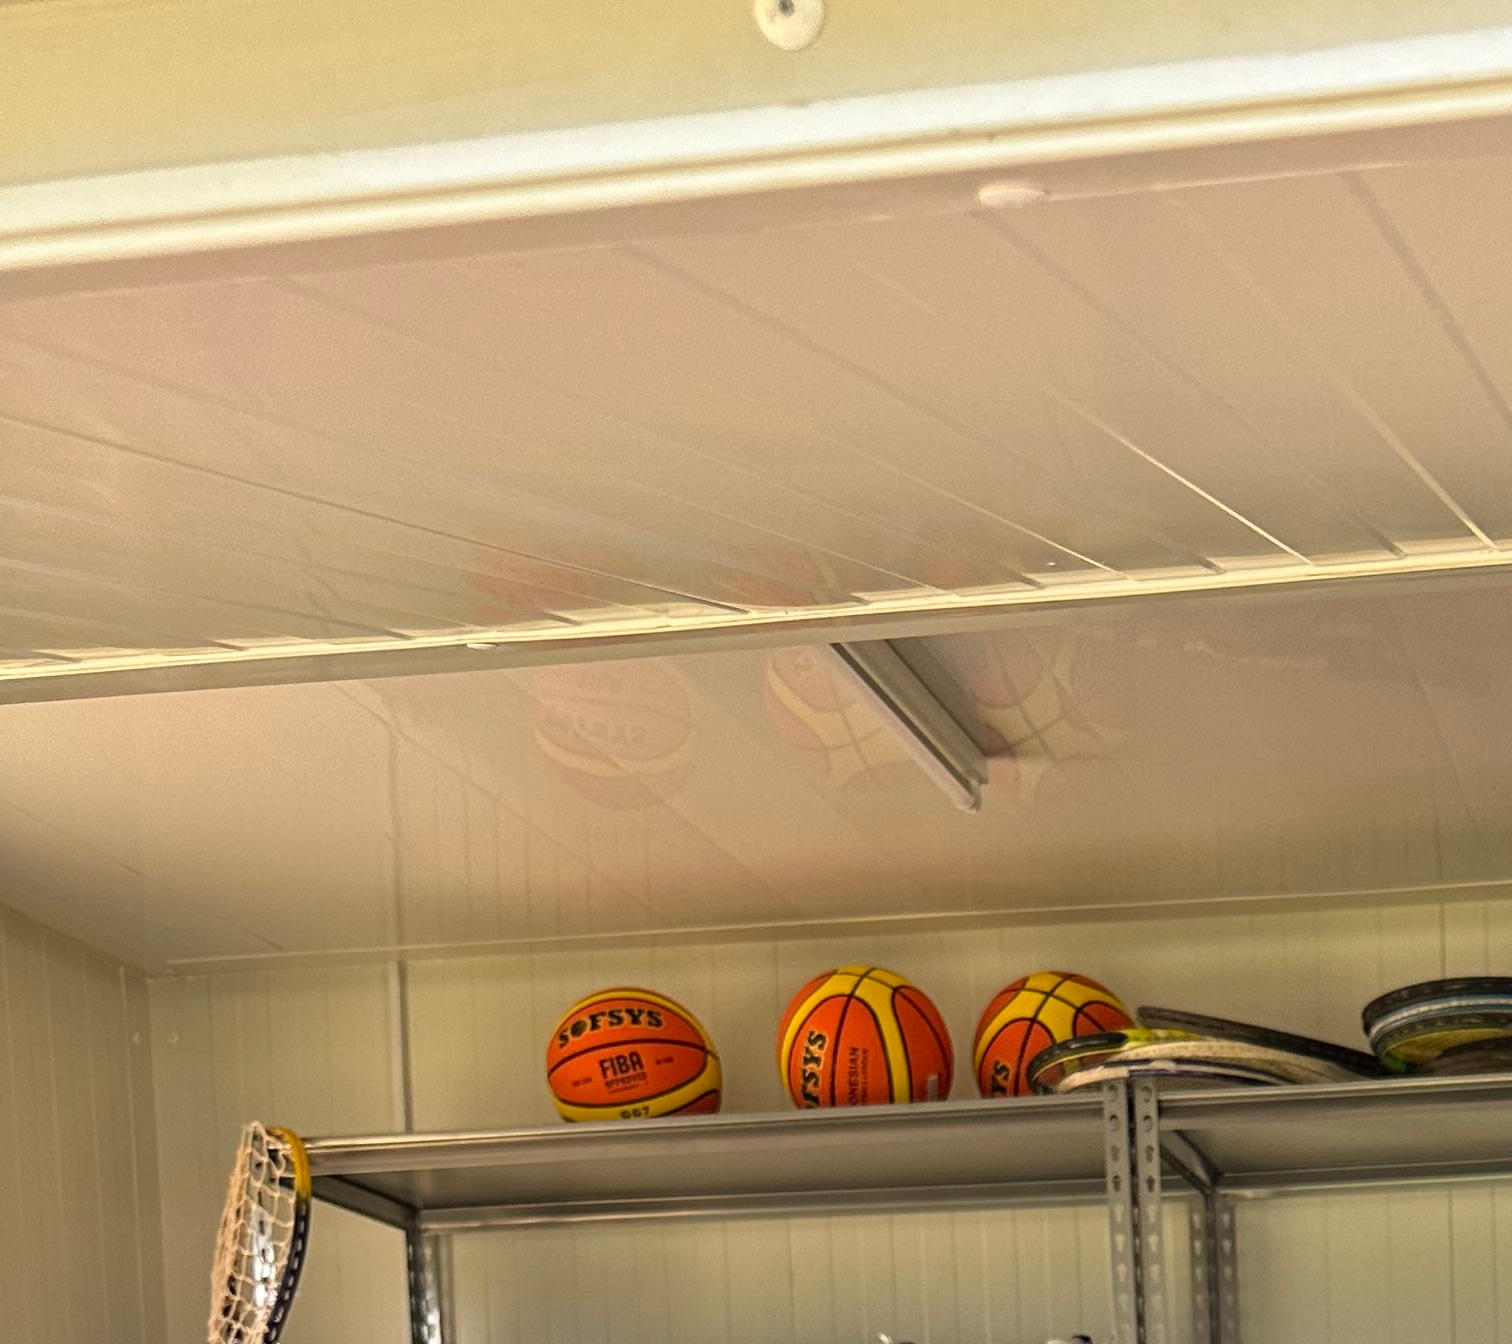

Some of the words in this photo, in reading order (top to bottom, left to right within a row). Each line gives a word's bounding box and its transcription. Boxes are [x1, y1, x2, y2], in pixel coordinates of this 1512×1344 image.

[558, 1008, 664, 1050] SOFSYS
[599, 1051, 645, 1080] FIBA
[801, 1030, 828, 1108] FSYS
